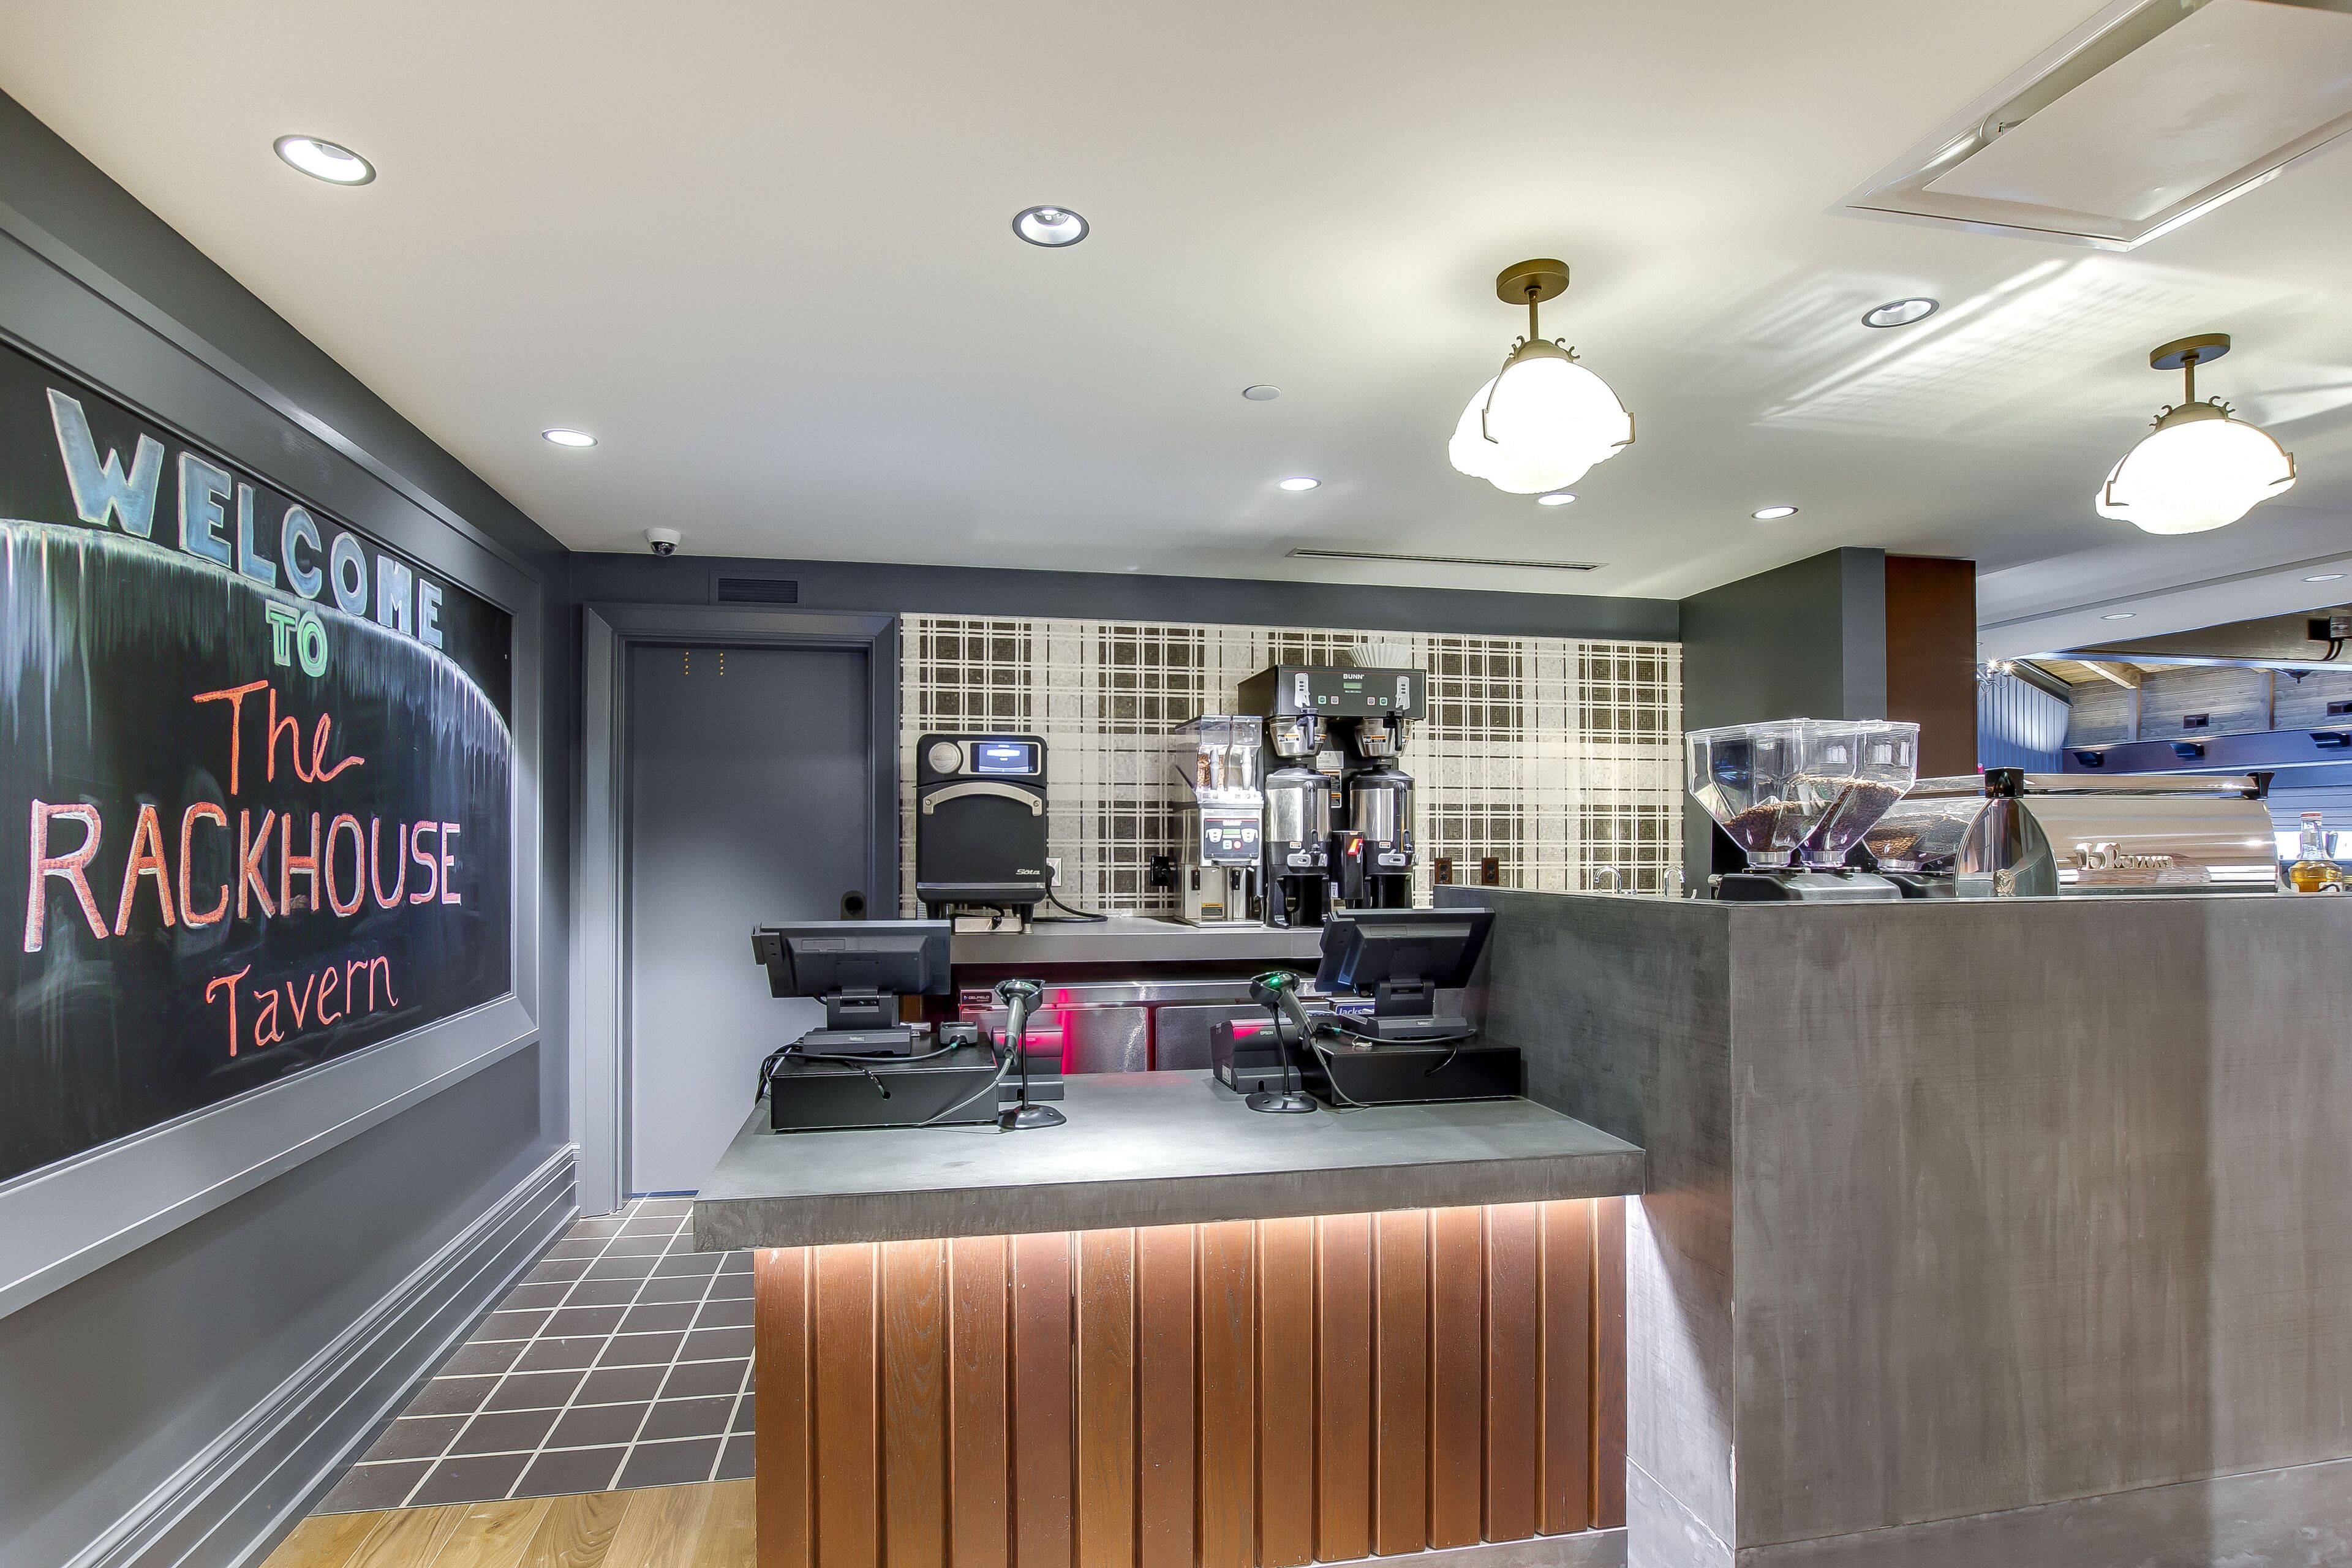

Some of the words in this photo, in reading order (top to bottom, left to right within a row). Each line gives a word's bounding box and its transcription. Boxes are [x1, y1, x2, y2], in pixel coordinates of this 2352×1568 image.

[46, 386, 443, 650] WELCOME
[265, 598, 328, 677] TO
[192, 679, 365, 795] The
[23, 798, 462, 953] RACKHOUSE
[205, 956, 398, 1057] Tavern
